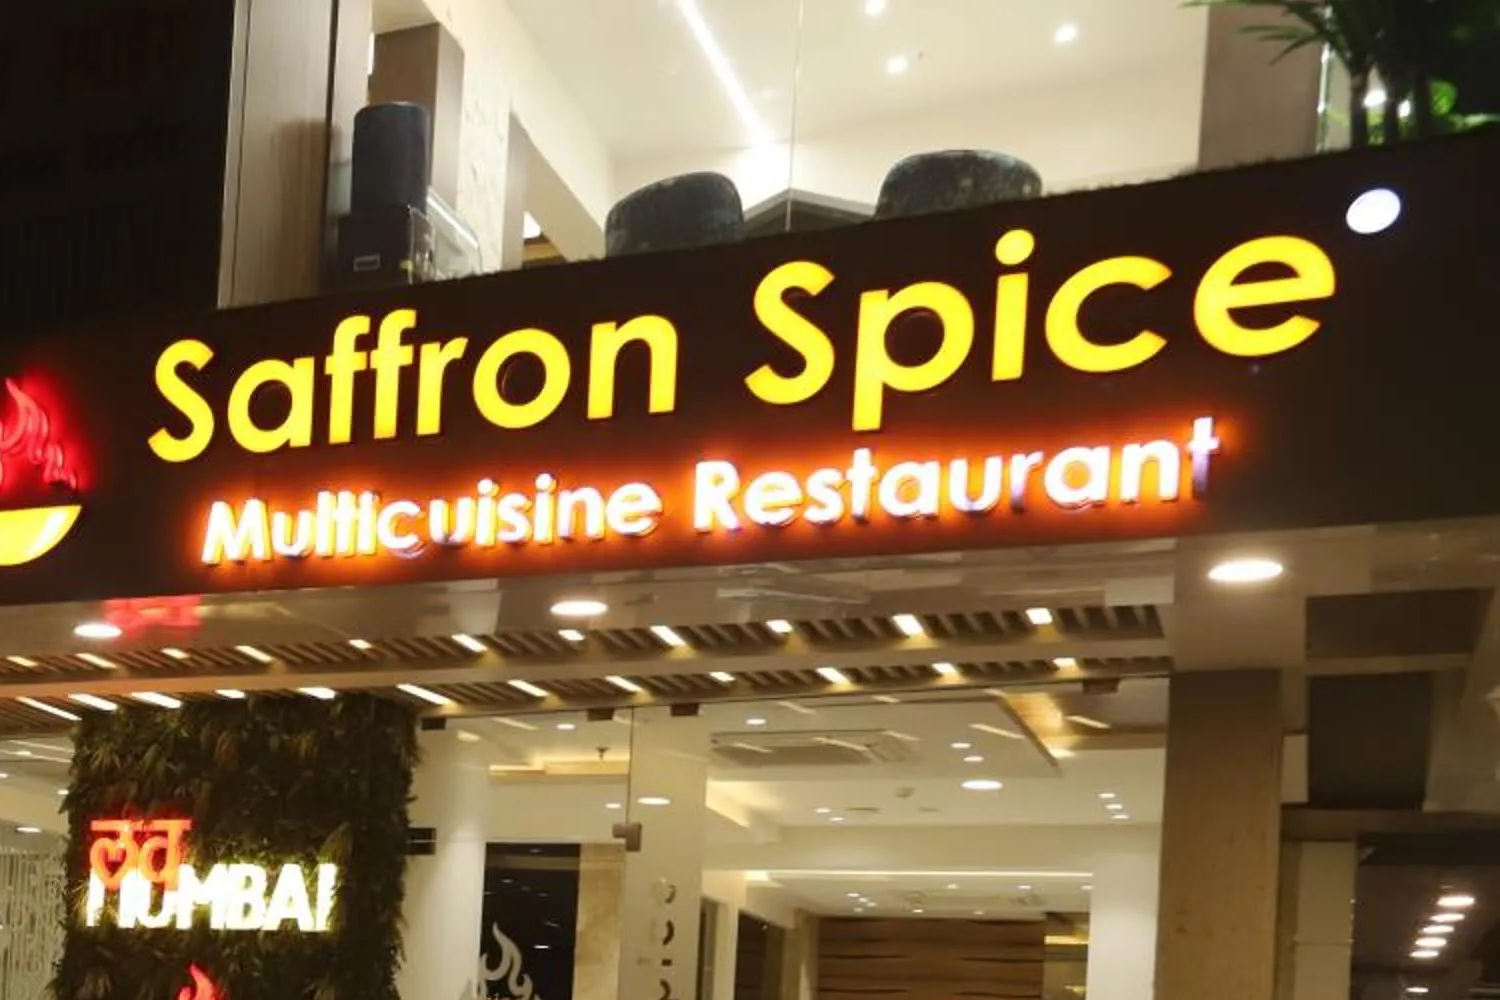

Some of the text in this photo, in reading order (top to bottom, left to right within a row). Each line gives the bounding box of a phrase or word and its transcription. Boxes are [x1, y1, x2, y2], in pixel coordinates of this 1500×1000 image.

[147, 229, 1337, 463] Saffron Spice
[201, 416, 1221, 566] Multicuisine Restaurant
[87, 863, 338, 932] MUMBAI
